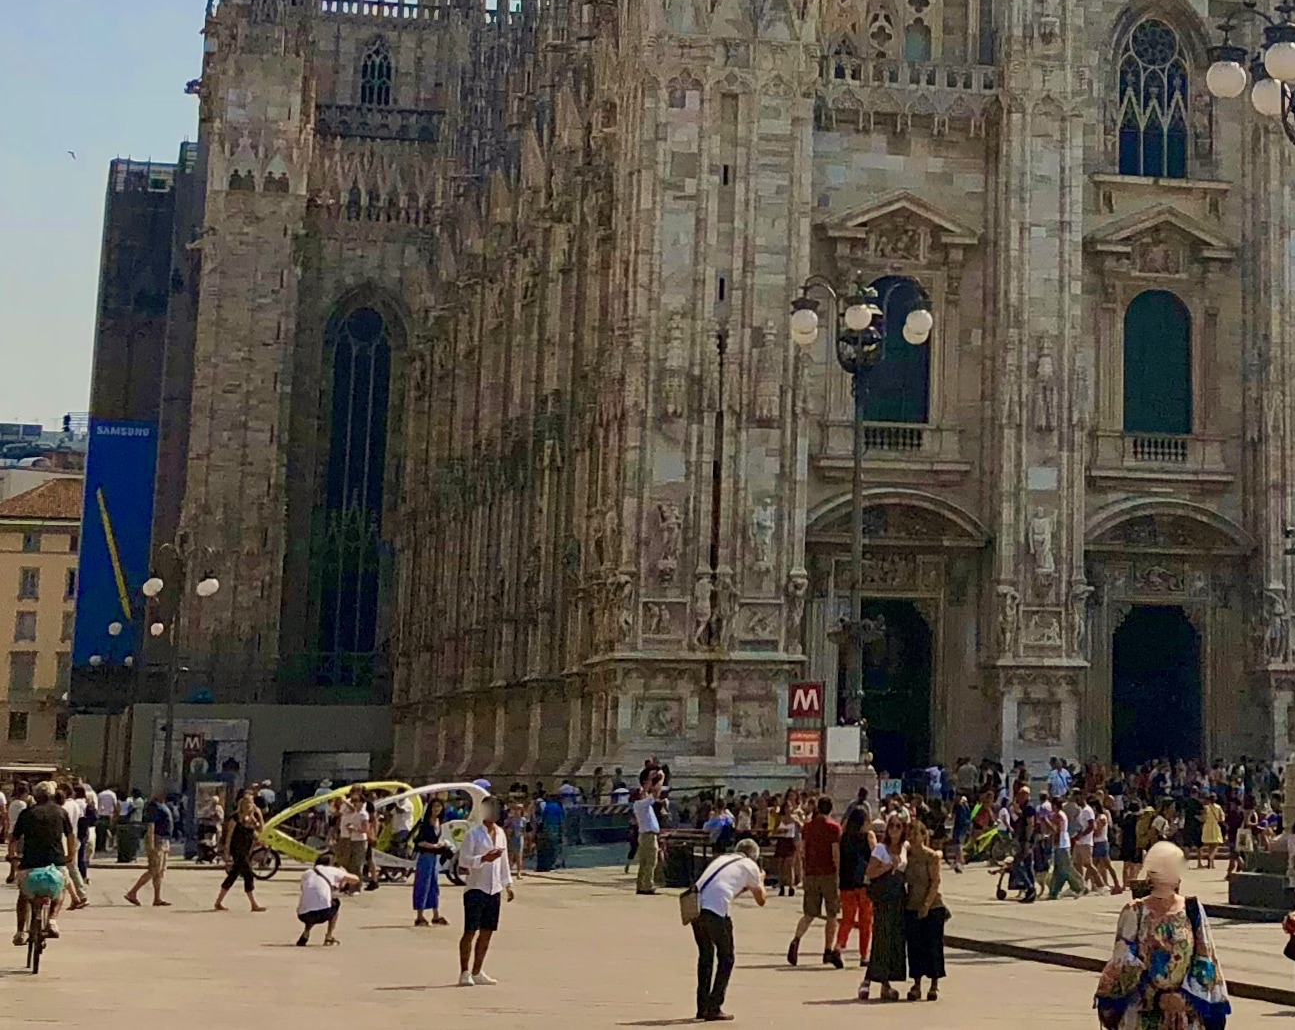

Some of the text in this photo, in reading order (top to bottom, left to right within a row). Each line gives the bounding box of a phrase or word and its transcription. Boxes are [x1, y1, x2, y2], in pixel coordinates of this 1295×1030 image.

[96, 425, 150, 437] SAMSUNG
[793, 689, 819, 710] M
[184, 736, 200, 749] M
